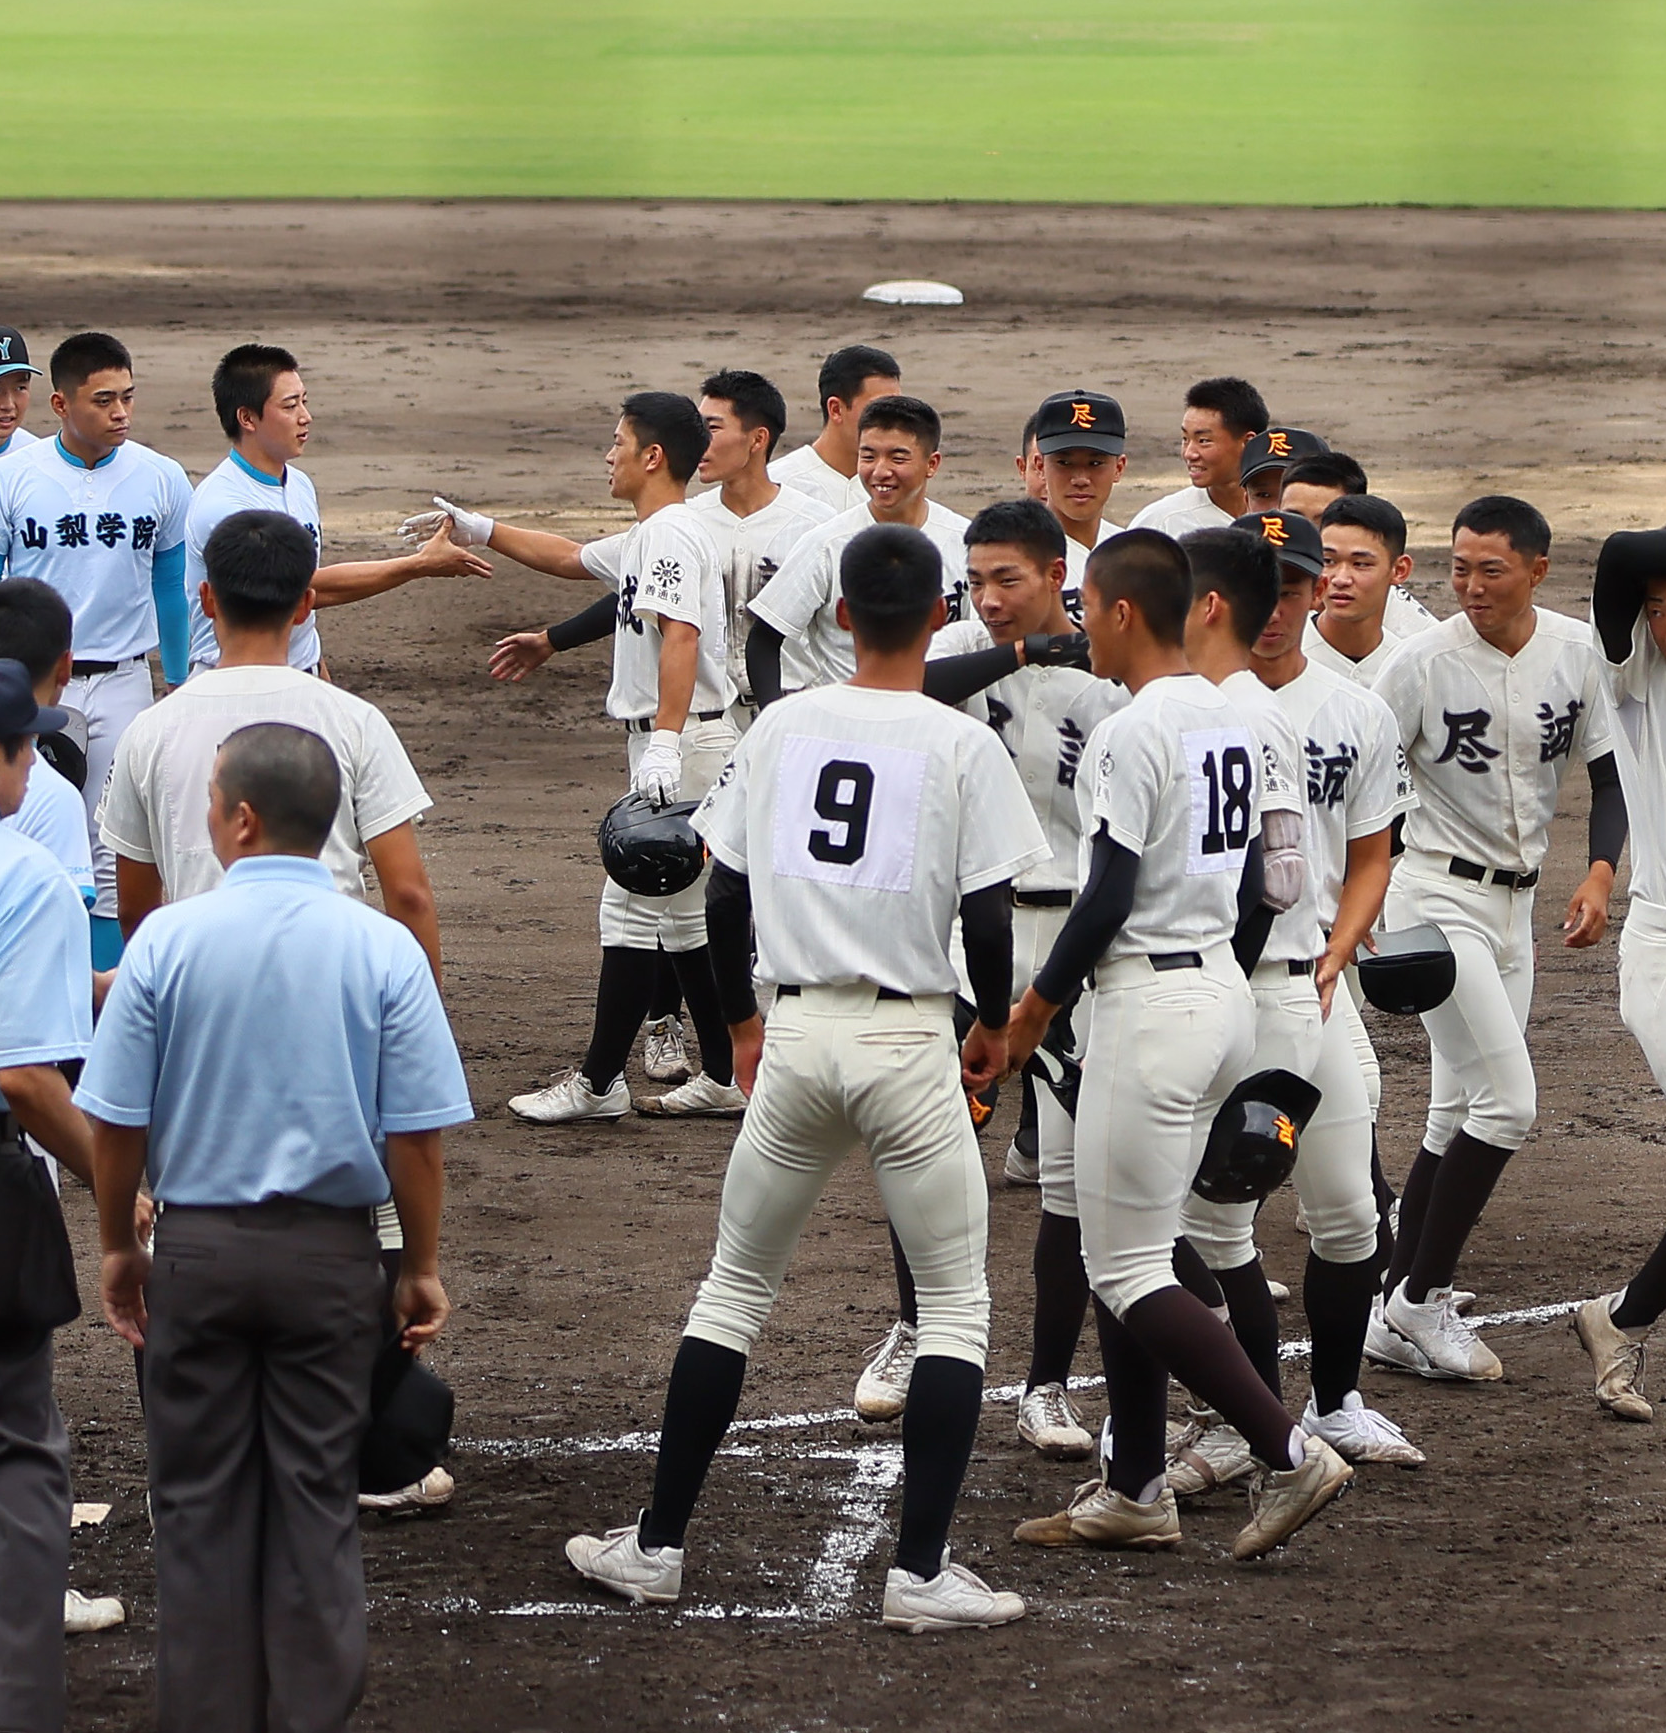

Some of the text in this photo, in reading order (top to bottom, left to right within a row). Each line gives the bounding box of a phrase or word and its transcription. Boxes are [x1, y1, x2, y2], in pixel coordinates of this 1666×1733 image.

[1070, 402, 1096, 429] 尽
[1267, 432, 1293, 457] 尽
[20, 512, 157, 550] 山梨学院
[1261, 516, 1290, 546] 尽
[807, 758, 876, 867] 9
[1201, 745, 1254, 856] 18
